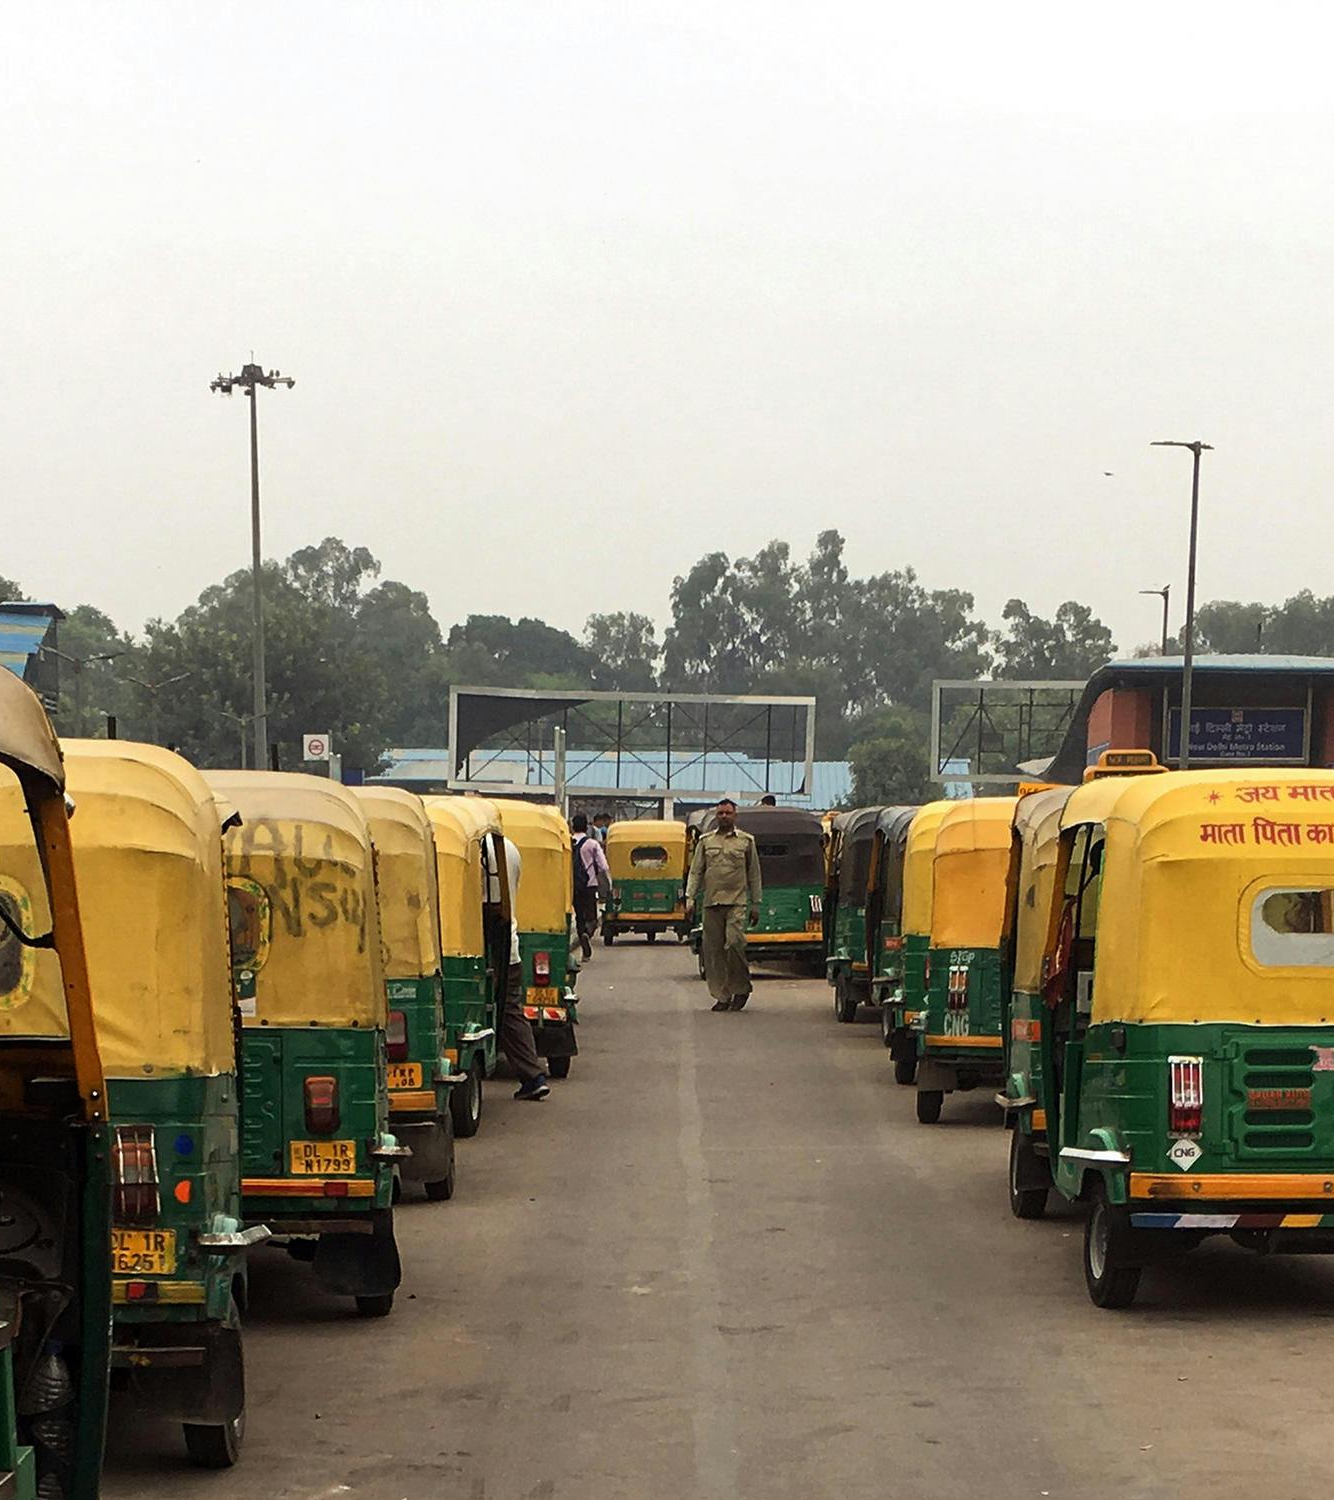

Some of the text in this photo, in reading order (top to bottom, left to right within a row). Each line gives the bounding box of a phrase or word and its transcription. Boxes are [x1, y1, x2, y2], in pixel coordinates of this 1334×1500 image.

[1235, 785, 1279, 803] जय
[1200, 822, 1245, 845] माता
[1253, 816, 1302, 847] पिता
[1306, 823, 1334, 844] का
[944, 1011, 970, 1037] CNG
[1174, 1147, 1196, 1158] CNG
